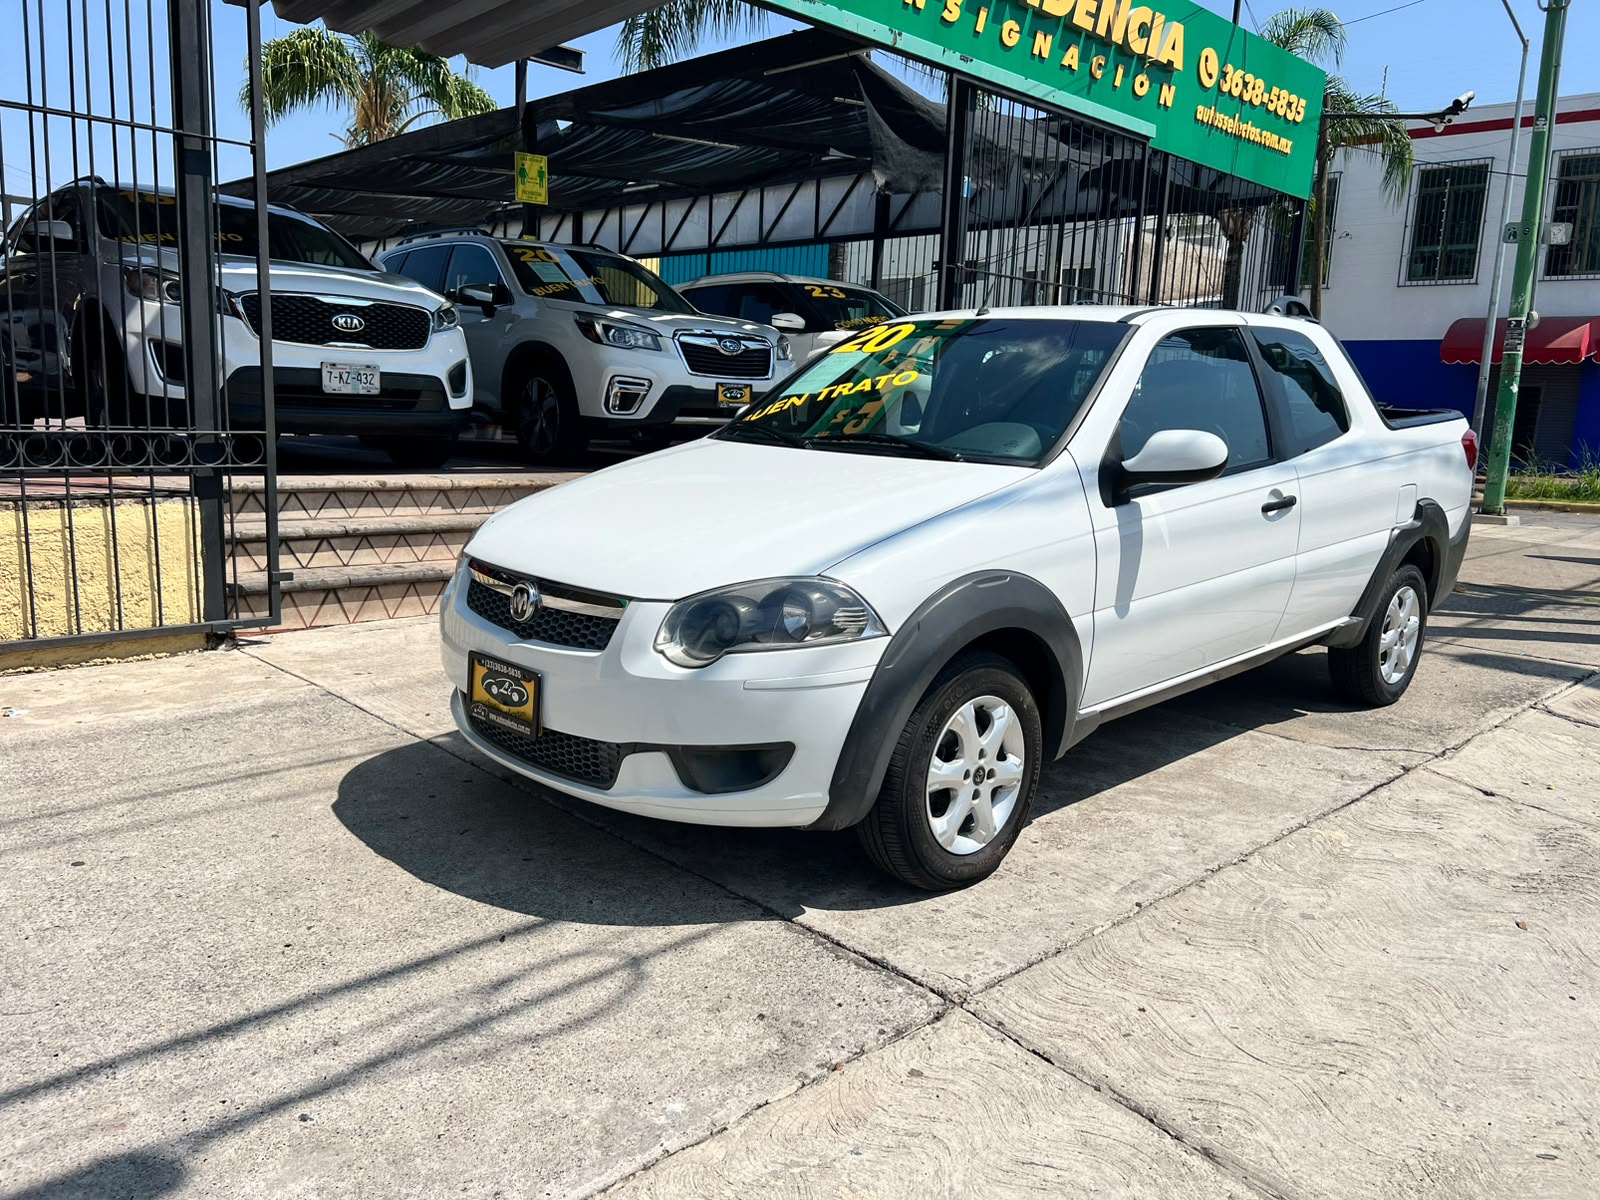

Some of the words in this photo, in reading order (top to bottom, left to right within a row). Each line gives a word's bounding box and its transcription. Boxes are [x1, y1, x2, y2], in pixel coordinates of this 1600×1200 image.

[1020, 0, 1184, 71] ENCIA
[1219, 63, 1307, 123] 3638-5835
[1195, 104, 1294, 155] autosselectos.com.mx
[513, 247, 560, 263] 20
[532, 282, 570, 297] BUEN
[568, 276, 606, 289] TRATO
[803, 285, 847, 299] 23
[337, 317, 360, 329] KIA
[834, 317, 864, 330] COMO
[828, 323, 917, 354] 20
[326, 370, 375, 386] 7-KZ-432
[816, 370, 919, 401] TRATO
